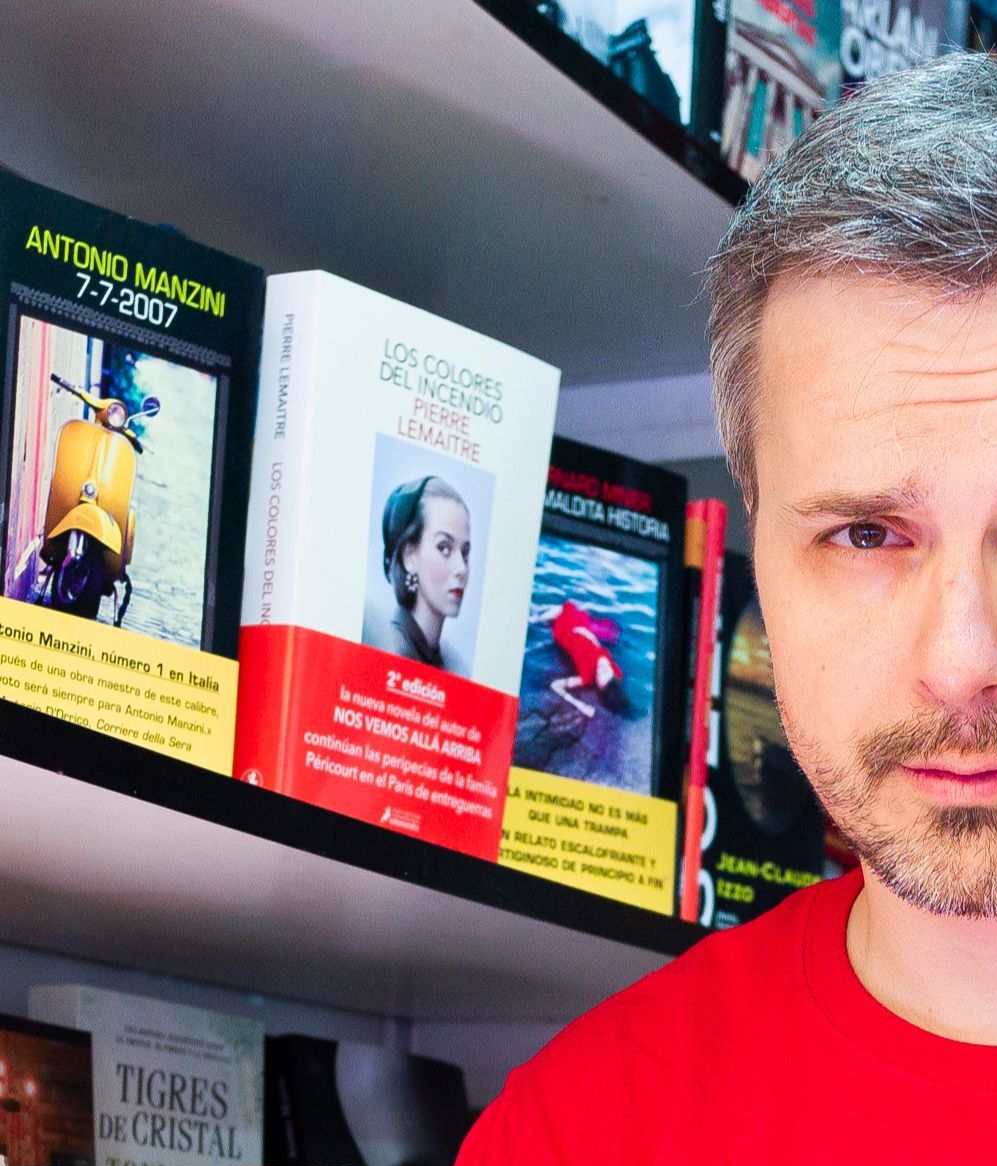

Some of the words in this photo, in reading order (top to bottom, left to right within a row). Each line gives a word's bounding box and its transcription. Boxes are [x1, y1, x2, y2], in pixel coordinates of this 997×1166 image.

[25, 225, 129, 283] ANTONIO
[135, 262, 226, 317] MANZINI
[76, 272, 178, 328] 7-7-2007
[280, 313, 295, 362] PIERRE
[380, 361, 412, 390] DEL
[418, 375, 503, 424] INCENDIO
[383, 338, 419, 367] LOS
[424, 354, 503, 401] COLORES
[274, 367, 290, 440] LEMAITRE
[414, 397, 470, 435] PIERRE
[398, 415, 480, 463] LEMAITRE
[271, 462, 282, 491] LOS
[264, 494, 280, 567] COLORES
[607, 506, 671, 542] HISTORIA
[262, 570, 274, 601] DEL
[30, 658, 44, 671] de
[46, 663, 66, 677] una
[70, 667, 94, 685] obra
[97, 678, 140, 697] maestra
[144, 687, 156, 700] de
[159, 693, 181, 707] este
[184, 698, 219, 718] calibre,
[39, 632, 95, 662] Manzini,
[101, 650, 150, 673] número
[156, 662, 164, 677] 1
[169, 668, 184, 682] en
[188, 671, 220, 692] Italia
[24, 679, 48, 695] será
[52, 686, 95, 707] siempre
[98, 699, 122, 714] para
[125, 704, 164, 724] Antonio
[340, 684, 351, 701] la
[353, 693, 385, 713] nueva
[386, 701, 421, 725] novela
[421, 711, 439, 730] del
[440, 719, 467, 738] autor
[467, 725, 482, 743] de
[402, 678, 446, 703] edición
[97, 718, 139, 739] Corriere
[142, 731, 166, 746] della
[168, 736, 193, 753] Sera
[333, 706, 364, 730] NOS
[365, 716, 409, 744] VEMOS
[410, 728, 440, 753] ALLÁ
[441, 740, 482, 766] ARRIBA
[304, 731, 364, 758] continúan
[365, 746, 380, 763] las
[382, 753, 438, 780] peripecias
[440, 767, 454, 784] de
[455, 771, 465, 788] la
[466, 775, 498, 799] familia
[305, 751, 358, 781] Péricourt
[359, 769, 374, 785] en
[375, 772, 387, 788] el
[415, 783, 430, 800] de
[430, 790, 493, 820] entreguerras
[525, 789, 585, 812] INTIMIDAD
[588, 801, 605, 816] NO
[608, 805, 621, 819] ES
[528, 809, 550, 825] QUE
[555, 814, 579, 830] UNA
[584, 819, 628, 840] TRAMPA
[514, 831, 557, 850] RELATO
[560, 839, 646, 868] ESCALOFRIANTE
[562, 859, 577, 873] DE
[581, 863, 635, 884] PRINCIPIO
[638, 873, 645, 885] A
[648, 876, 664, 890] FIN
[116, 1062, 230, 1121] TIGRES
[99, 1113, 127, 1143] DE
[131, 1109, 242, 1161] CRISTAL
